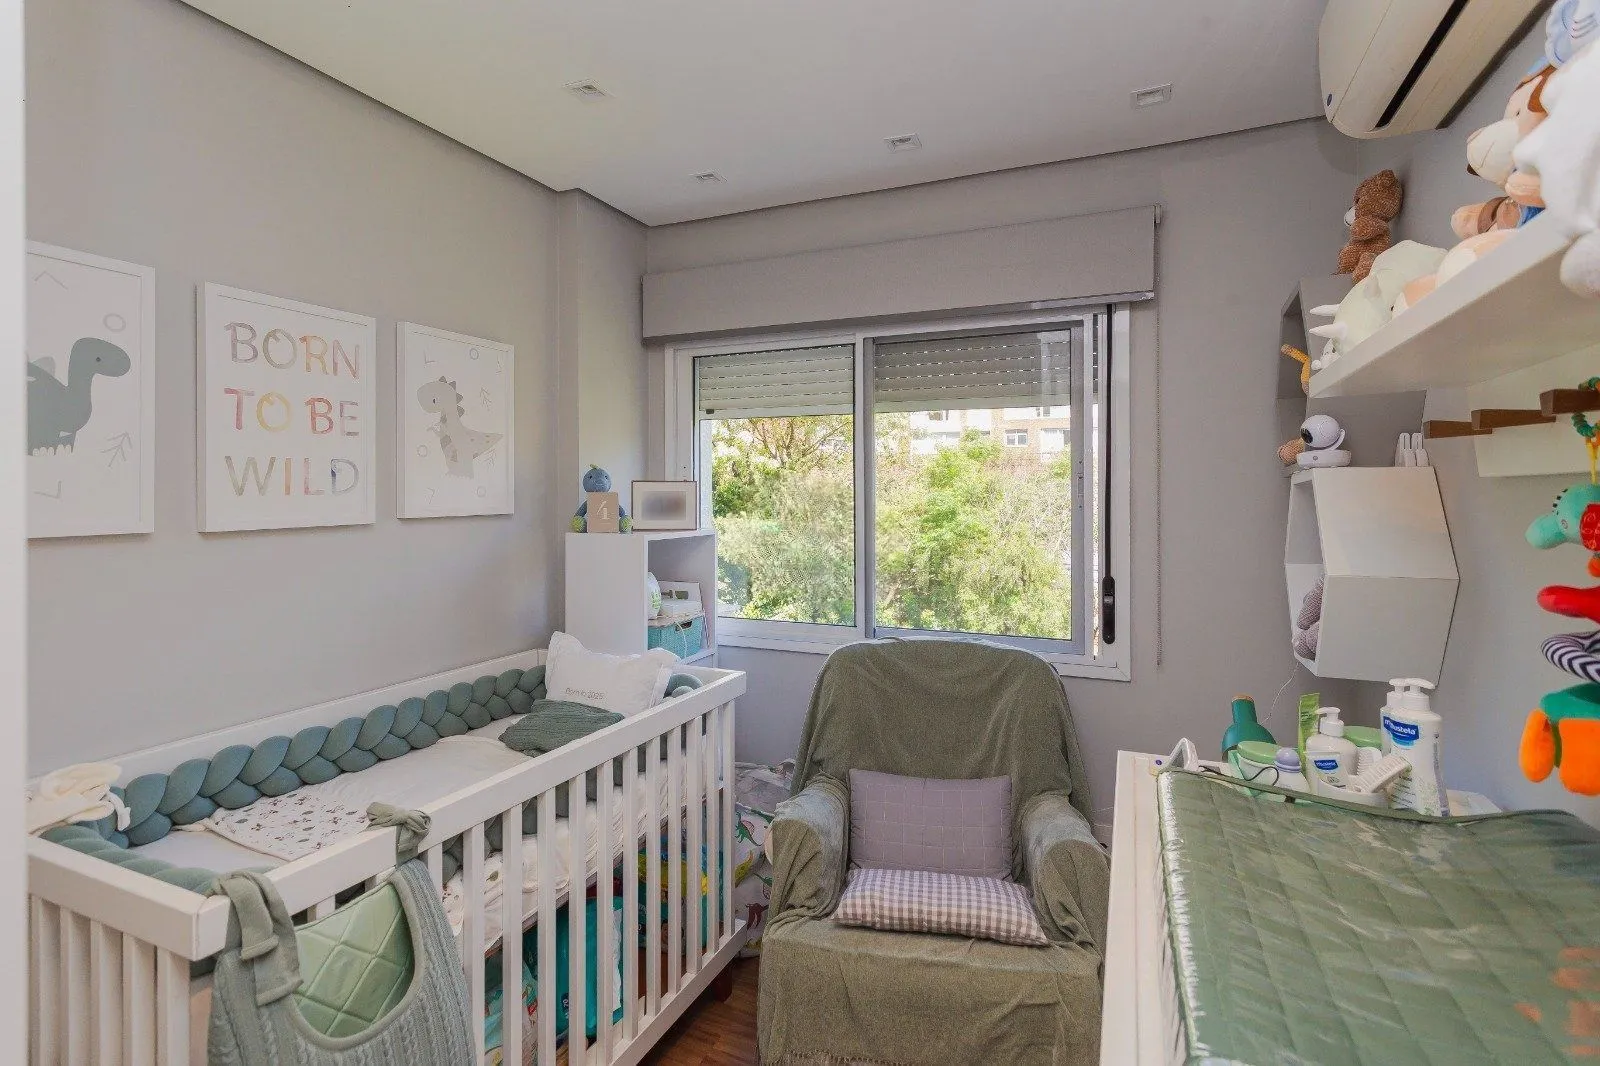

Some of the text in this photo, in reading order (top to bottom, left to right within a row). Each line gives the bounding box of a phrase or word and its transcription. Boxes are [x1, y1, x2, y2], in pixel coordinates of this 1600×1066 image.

[224, 322, 360, 380] BORN
[224, 387, 360, 437] TO BE
[224, 455, 360, 497] WILD
